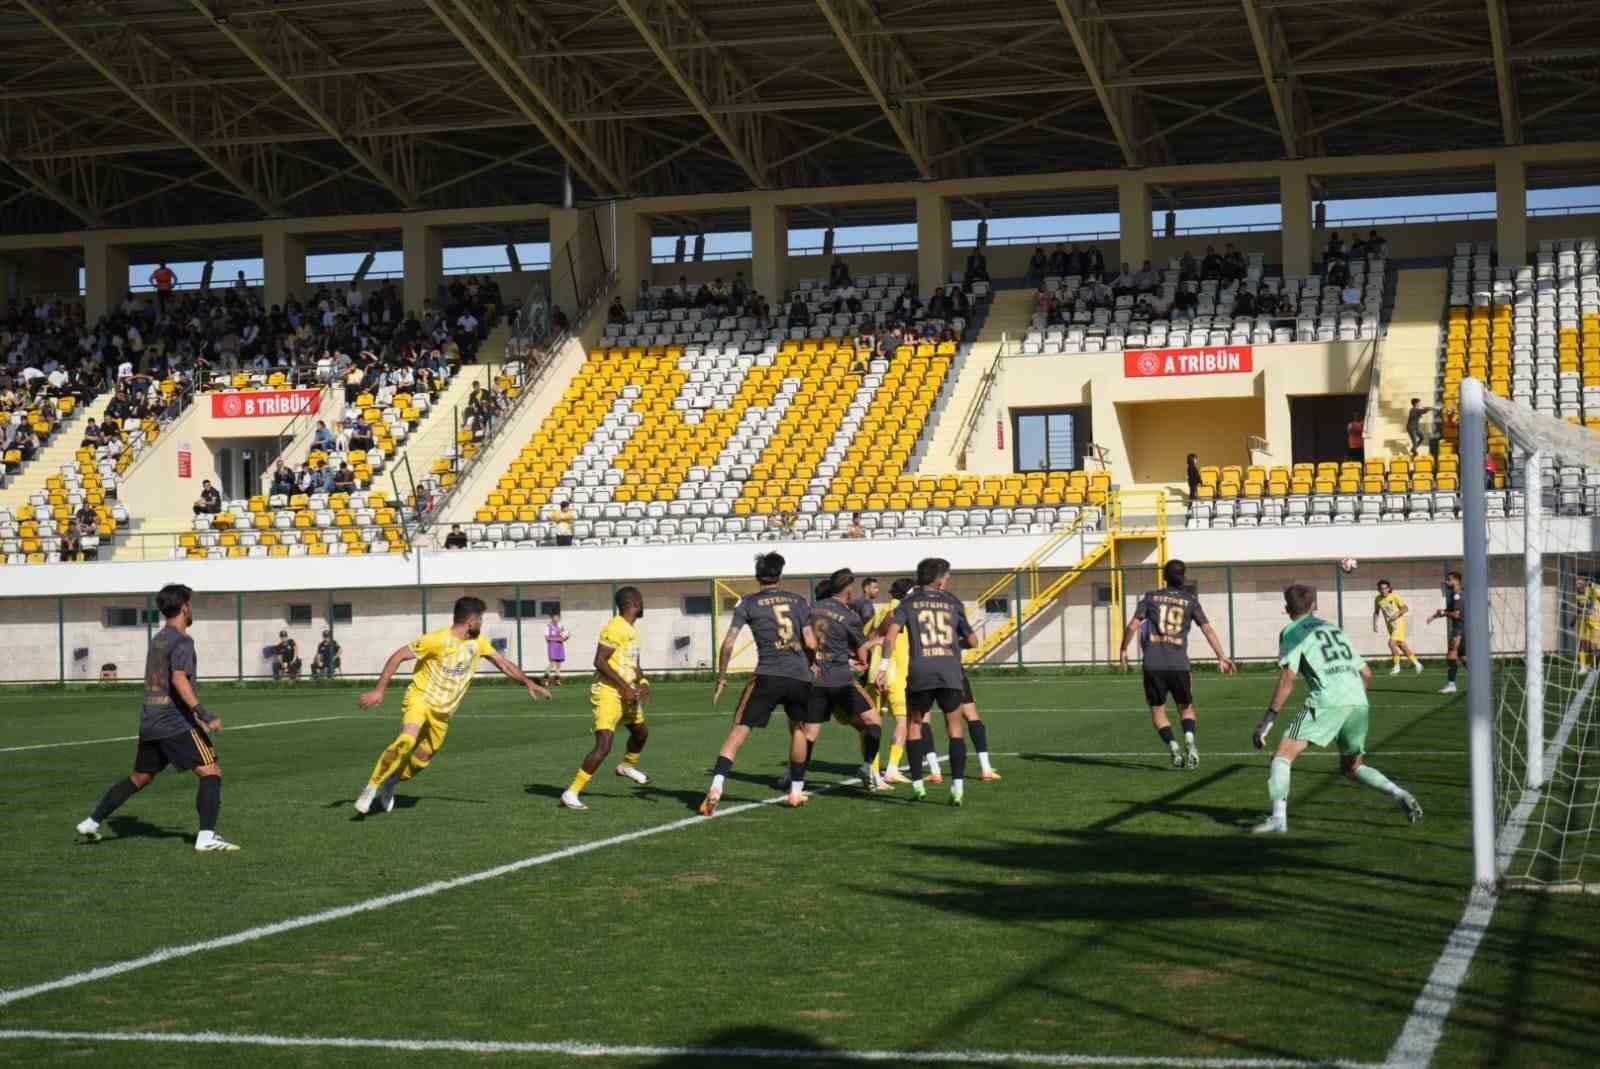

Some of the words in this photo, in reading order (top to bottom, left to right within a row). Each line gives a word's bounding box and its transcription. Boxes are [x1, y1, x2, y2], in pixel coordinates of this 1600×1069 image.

[1164, 356, 1175, 374] A
[1178, 350, 1240, 373] TRİBÜN
[244, 399, 255, 415] B
[257, 394, 311, 414] TRİBÜN
[772, 604, 793, 640] 5
[918, 610, 953, 646] 35
[1159, 604, 1184, 633] 19
[1315, 630, 1353, 663] 25
